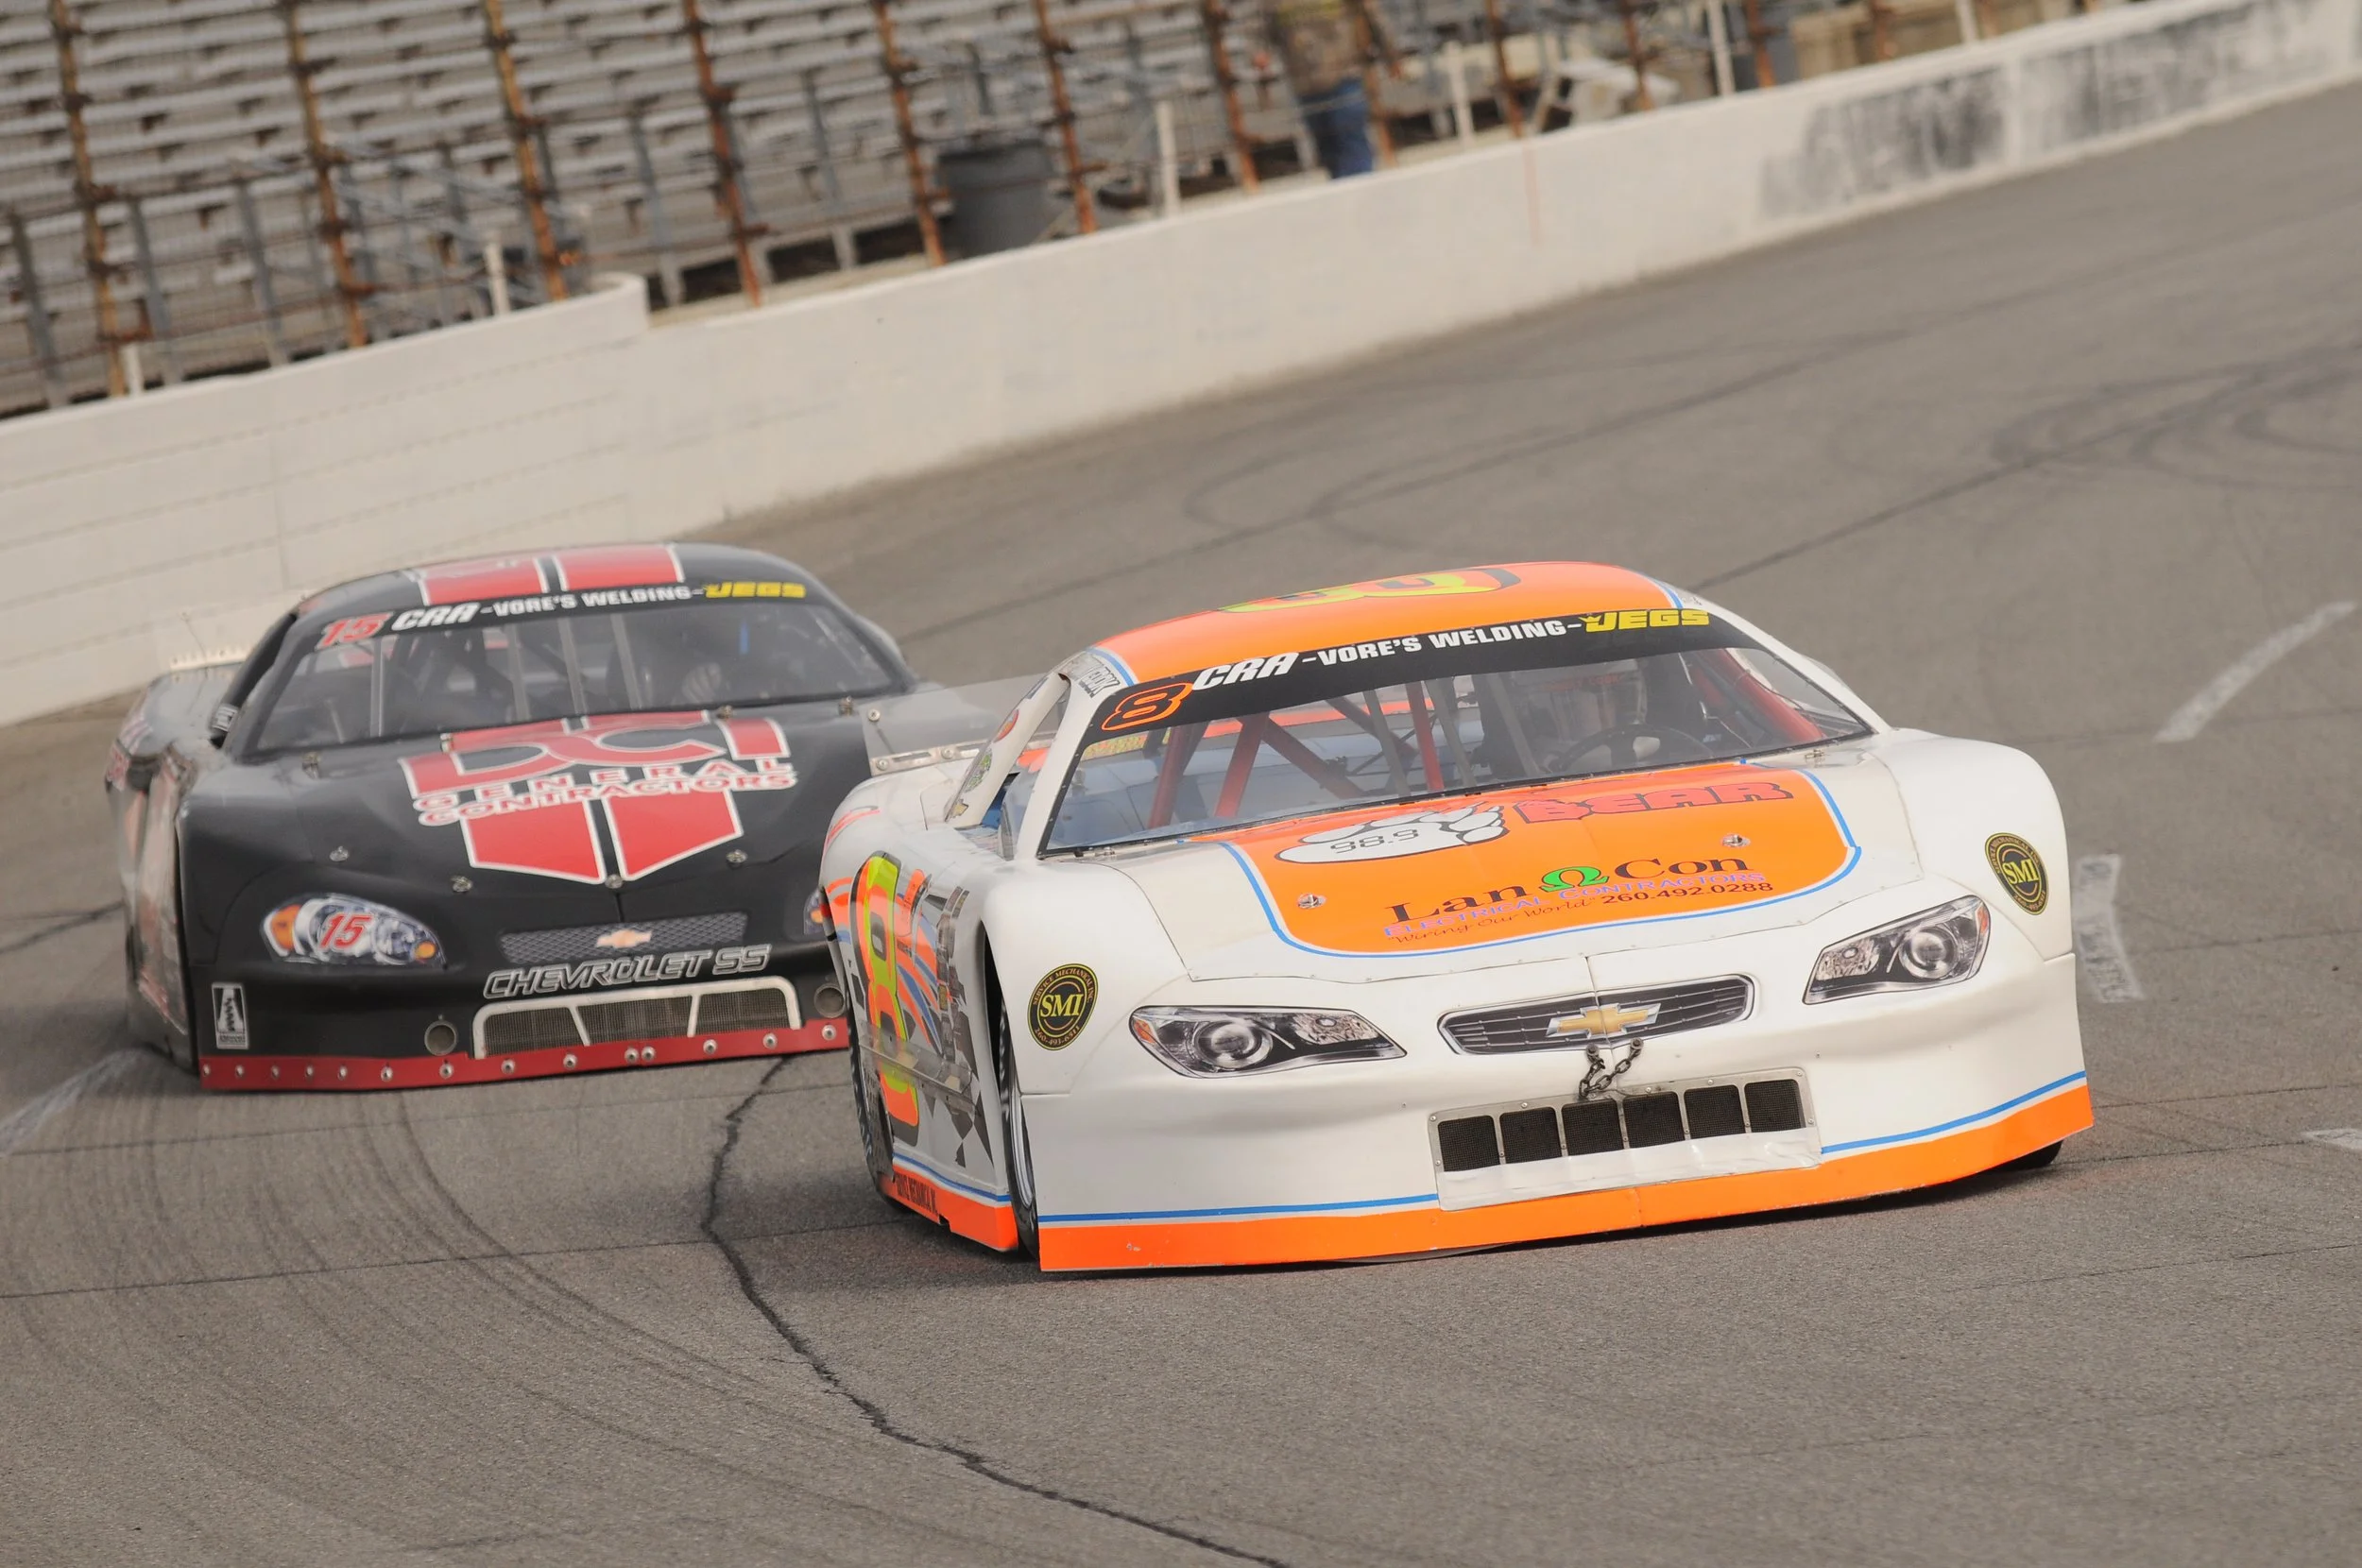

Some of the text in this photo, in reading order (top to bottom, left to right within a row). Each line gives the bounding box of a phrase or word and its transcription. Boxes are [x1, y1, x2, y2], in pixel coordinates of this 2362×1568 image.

[316, 612, 394, 651] 15
[391, 602, 481, 631] CRA
[1101, 682, 1194, 731] 8
[1191, 652, 1300, 691] CRA
[1579, 609, 1709, 634] JEGS
[412, 757, 795, 812] GENERAL
[418, 771, 799, 827] CONTRACTORS
[1329, 782, 1794, 854] 98.9 BEAR
[1384, 884, 1536, 925] Lan
[1614, 857, 1754, 880] Con
[2002, 858, 2041, 885] SMI
[317, 912, 374, 949] 15
[1382, 872, 1767, 937] ELECTRICAL CONTRACTORS
[1476, 913, 1520, 928] Our
[1601, 881, 1774, 905] 260.492.0288
[483, 943, 774, 1000] CHEVROLET SS
[1040, 994, 1084, 1017] SMI
